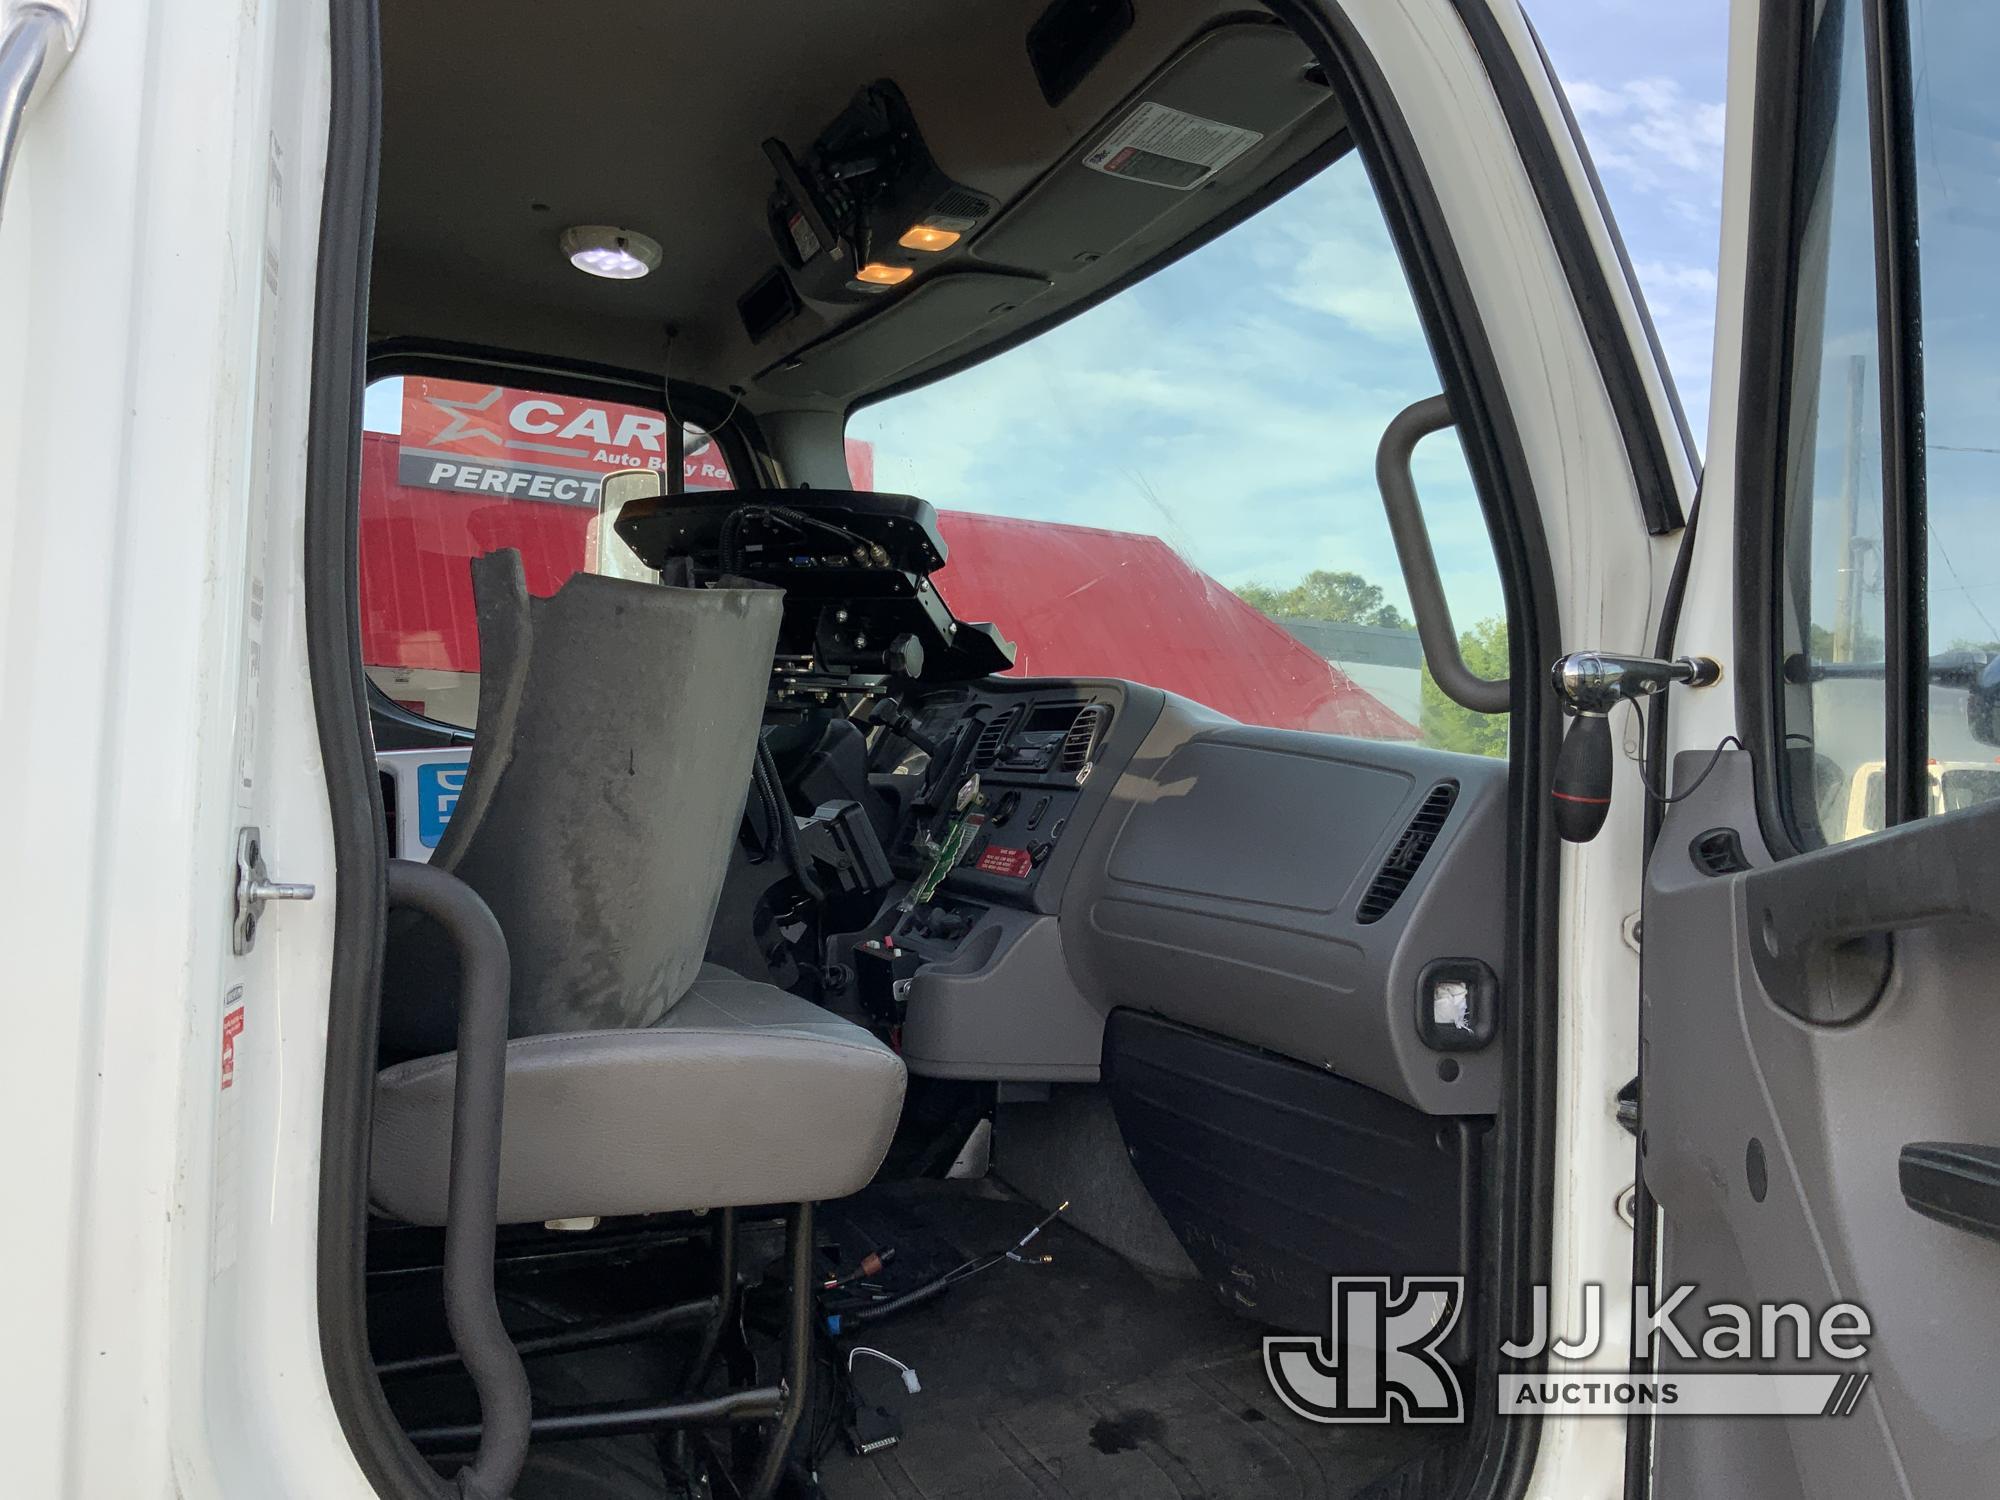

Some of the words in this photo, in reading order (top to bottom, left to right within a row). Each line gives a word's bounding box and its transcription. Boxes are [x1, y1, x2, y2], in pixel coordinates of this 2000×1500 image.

[593, 450, 641, 468] Auto
[648, 457, 697, 477] By
[429, 462, 599, 503] PERFECT
